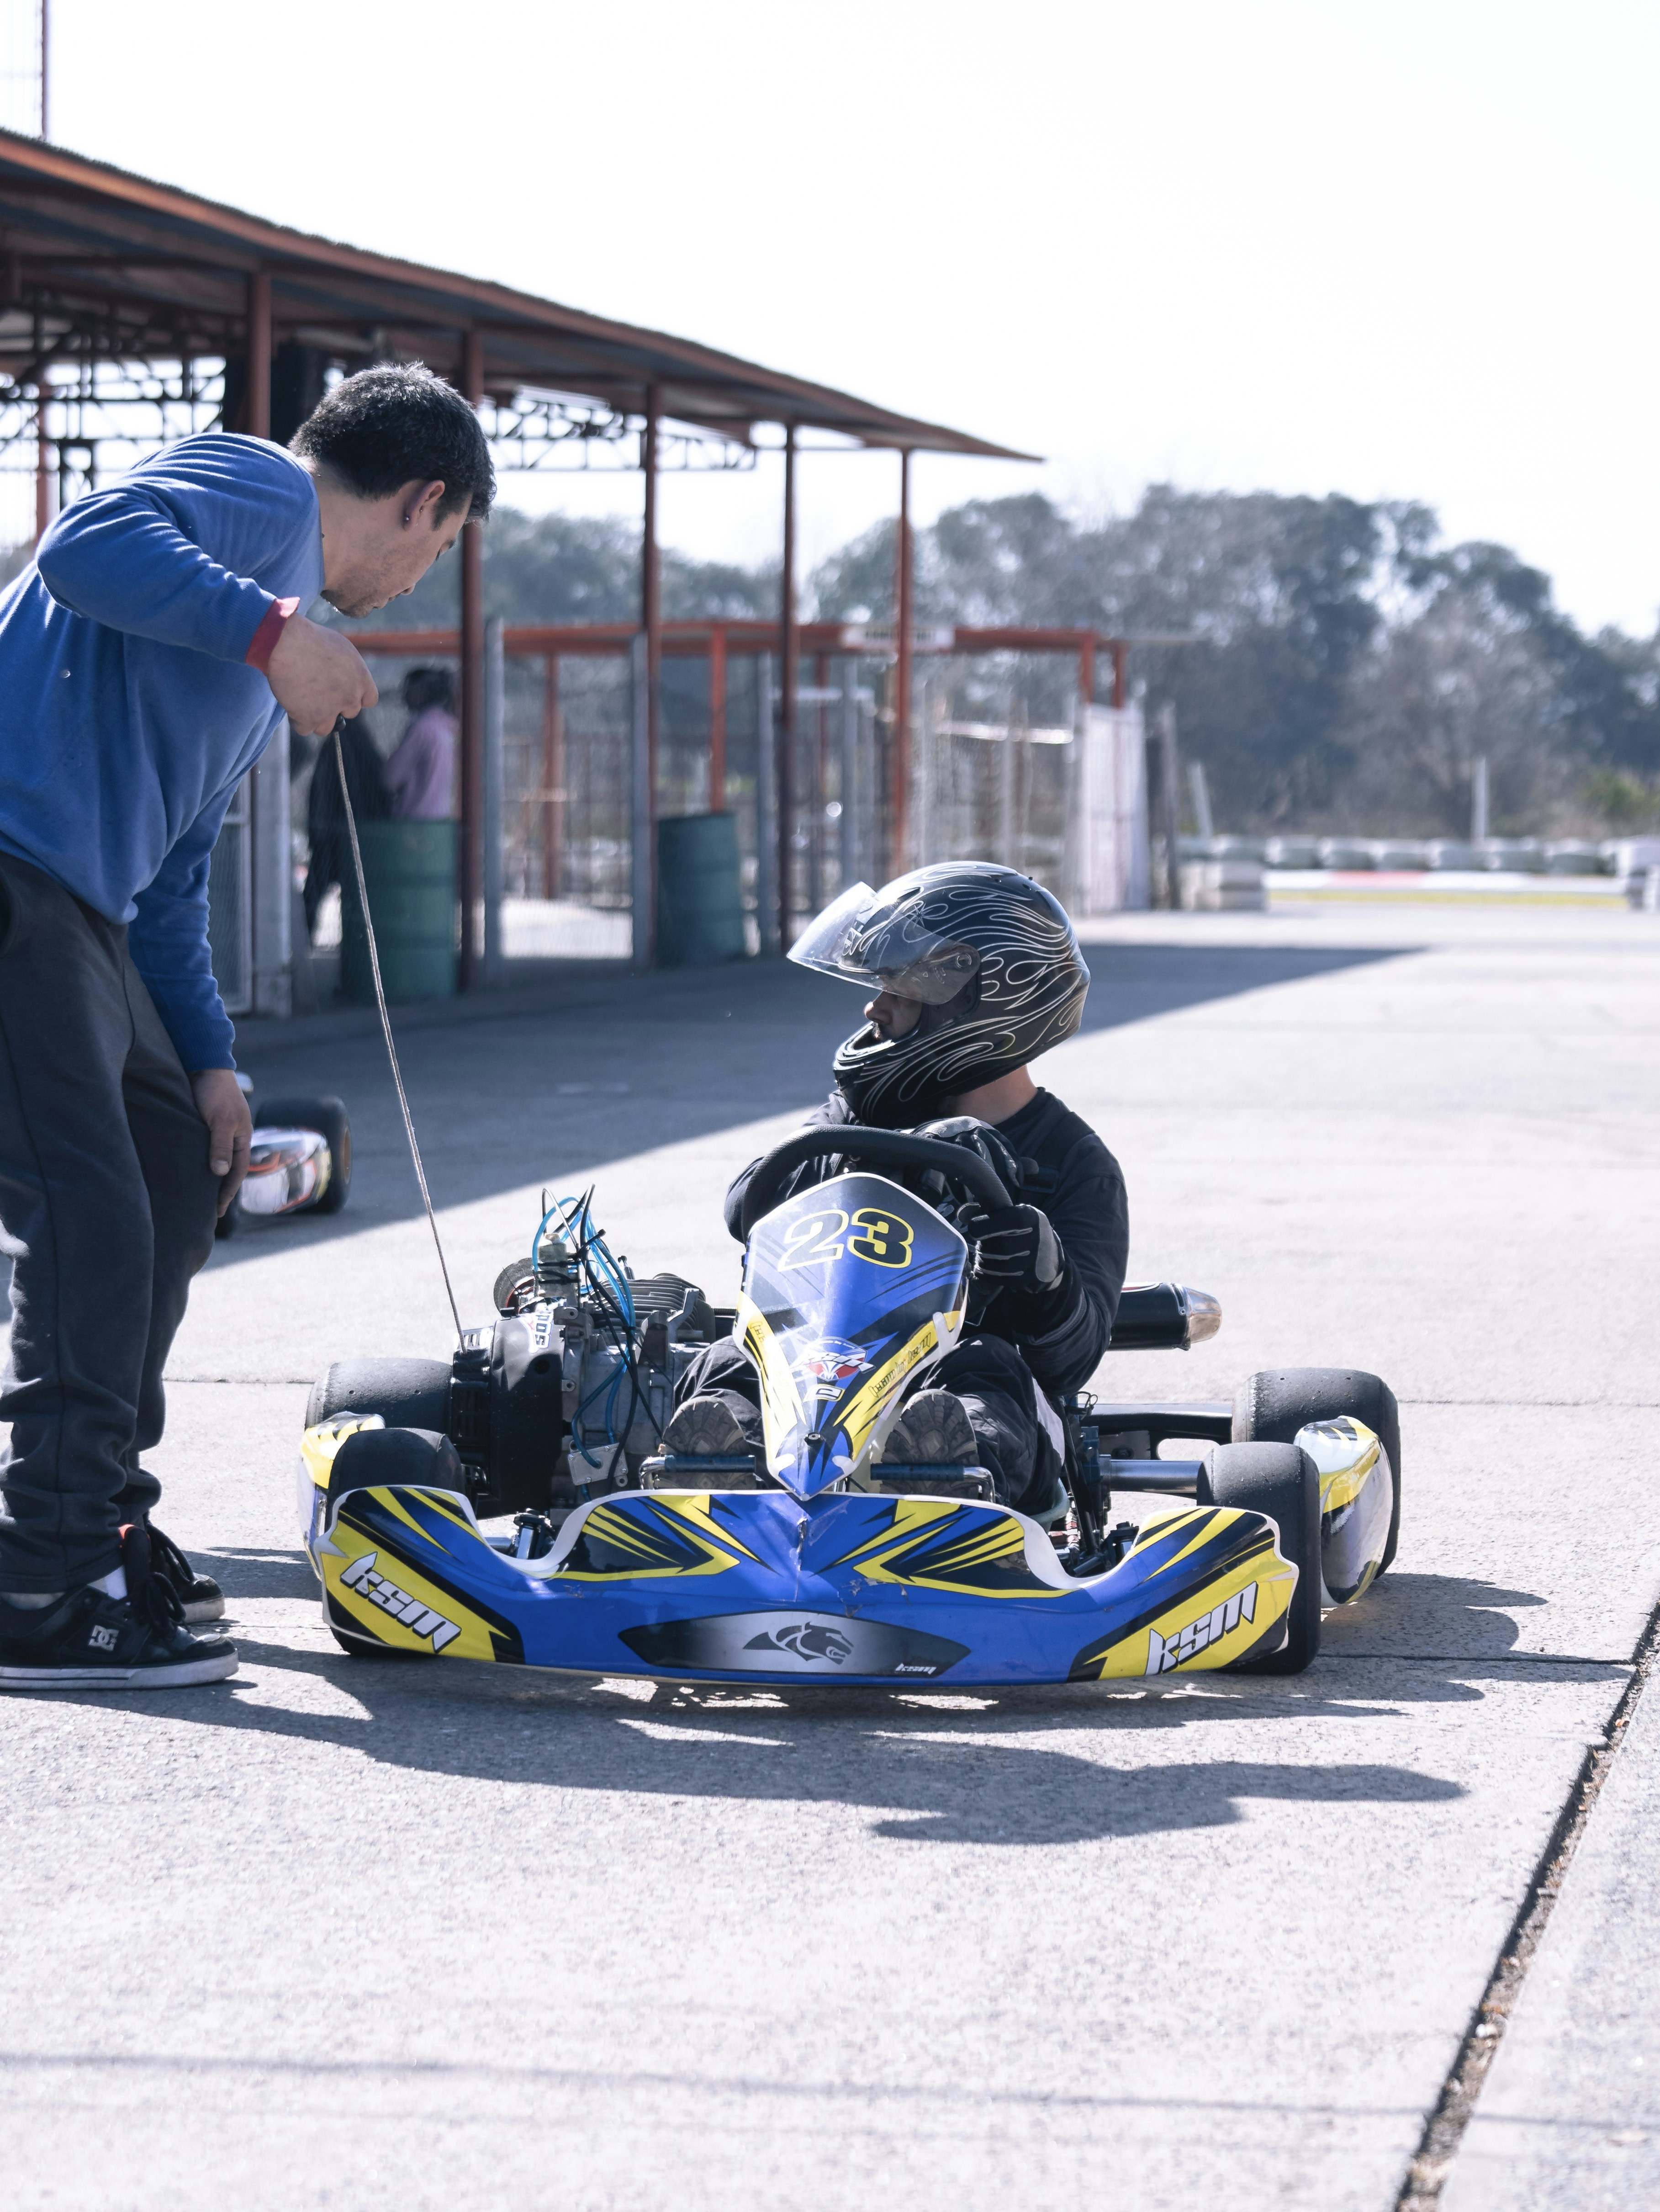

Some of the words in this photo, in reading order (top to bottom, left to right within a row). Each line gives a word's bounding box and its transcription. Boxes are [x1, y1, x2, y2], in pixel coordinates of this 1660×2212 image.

[777, 1208, 915, 1272] 23
[340, 1551, 462, 1654] ksm
[1145, 1581, 1258, 1676] ksm
